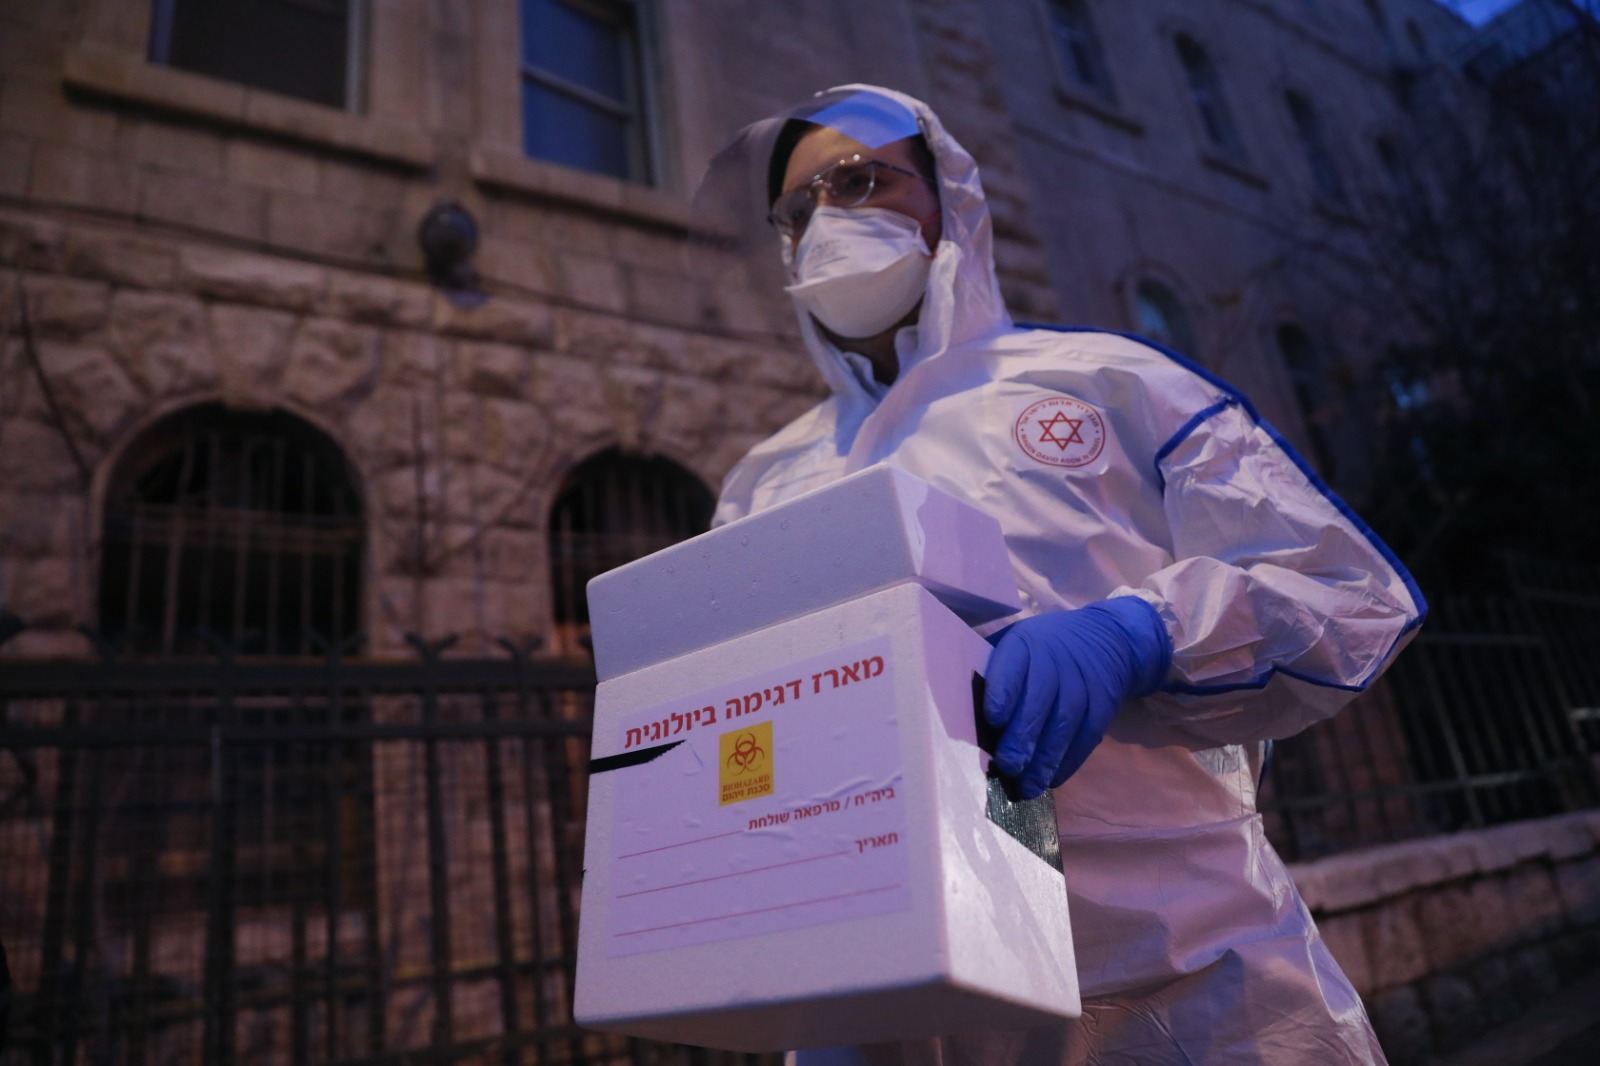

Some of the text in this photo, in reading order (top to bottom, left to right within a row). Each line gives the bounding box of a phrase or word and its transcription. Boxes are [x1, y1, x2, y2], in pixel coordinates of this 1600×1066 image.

[1036, 451, 1059, 463] DAVID
[1060, 457, 1082, 465] ADOM
[624, 655, 884, 749] מארז דגימה ביולוגית
[722, 774, 770, 792] BIOHAZARD
[722, 783, 770, 802] סכנת זיהום
[794, 800, 841, 820] מרפאה
[748, 811, 790, 830] שולחת
[854, 831, 899, 854] תאריך
